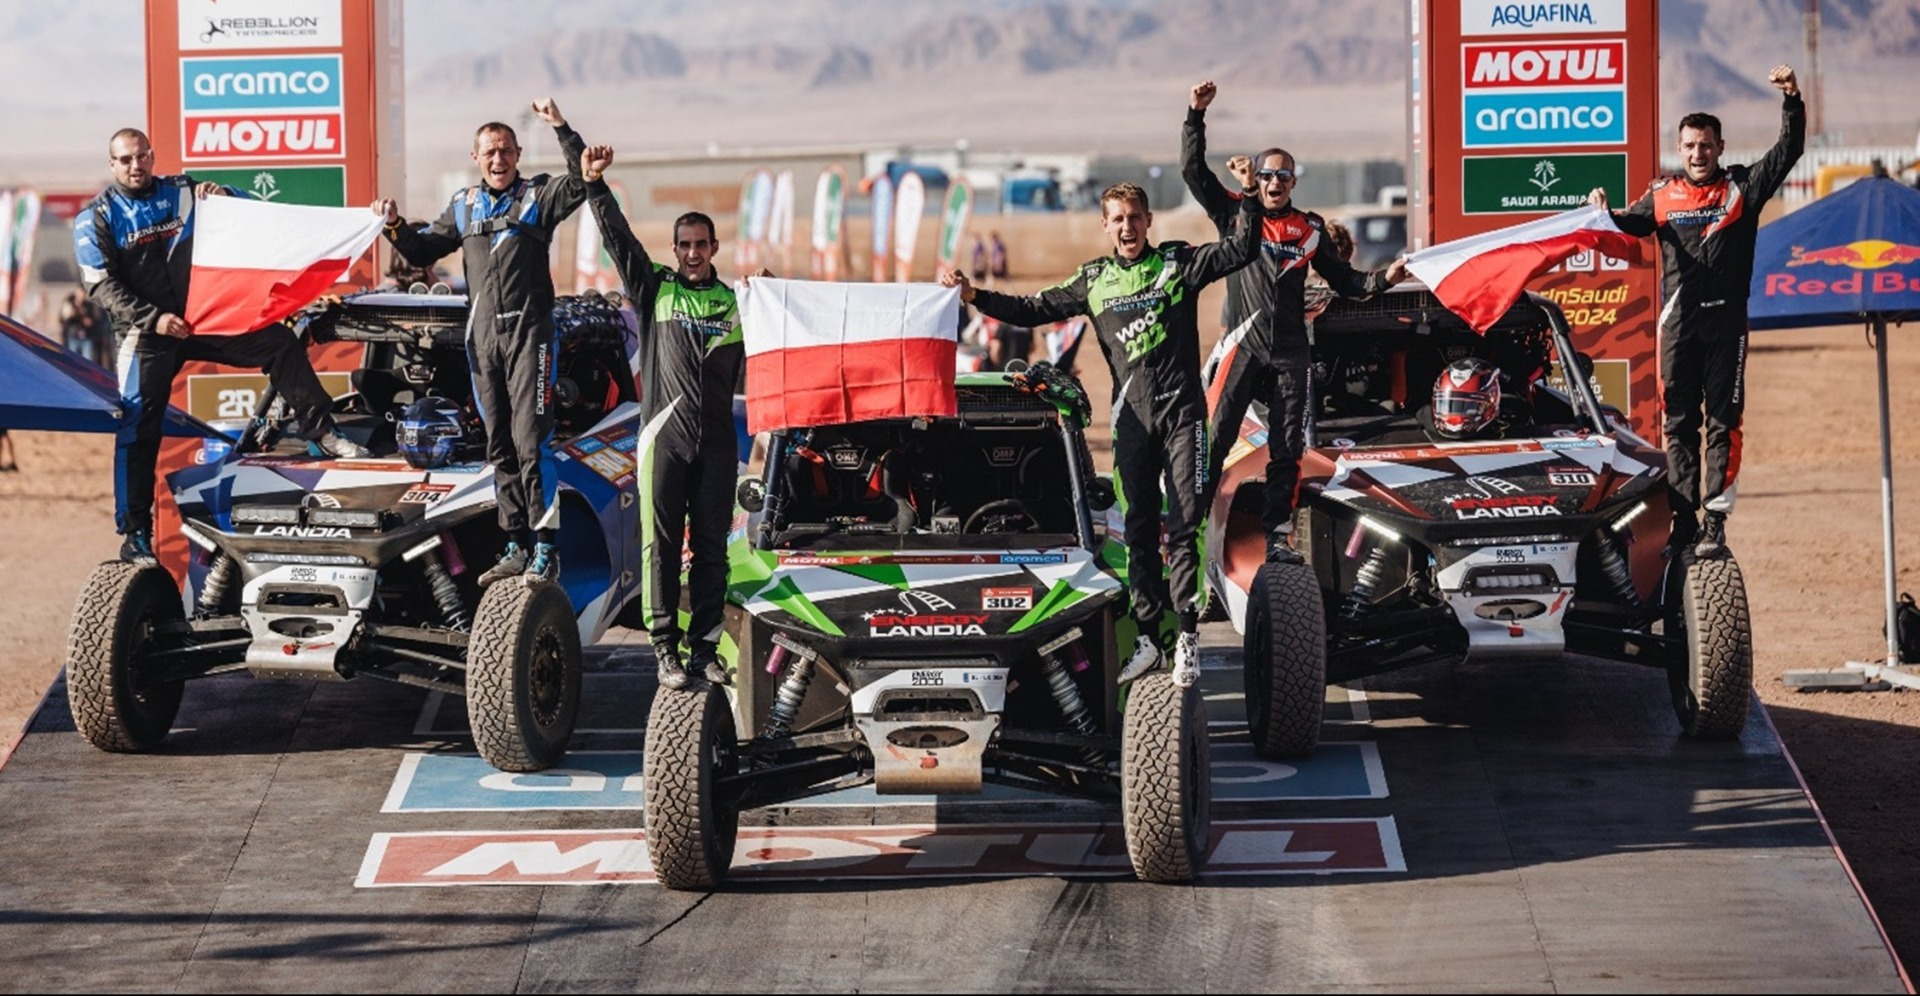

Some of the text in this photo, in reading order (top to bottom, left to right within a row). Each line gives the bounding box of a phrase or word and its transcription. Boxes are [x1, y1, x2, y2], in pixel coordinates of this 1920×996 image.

[1491, 3, 1592, 28] AQUAFINA
[1472, 49, 1617, 82] MOTUL
[194, 71, 330, 96] aramco
[1476, 105, 1614, 131] aramco
[191, 119, 335, 152] MOTUL
[1501, 194, 1590, 207] SAUDI ARABIA
[1765, 271, 1863, 296] Red
[1564, 308, 1617, 325] 2024
[1553, 474, 1588, 484] 310
[402, 491, 441, 503] 304
[1456, 505, 1562, 520] LANDIA
[254, 526, 352, 539] LANDIA
[987, 598, 1026, 608] 302
[870, 614, 991, 627] ENERGY
[870, 624, 986, 637] LANDIA
